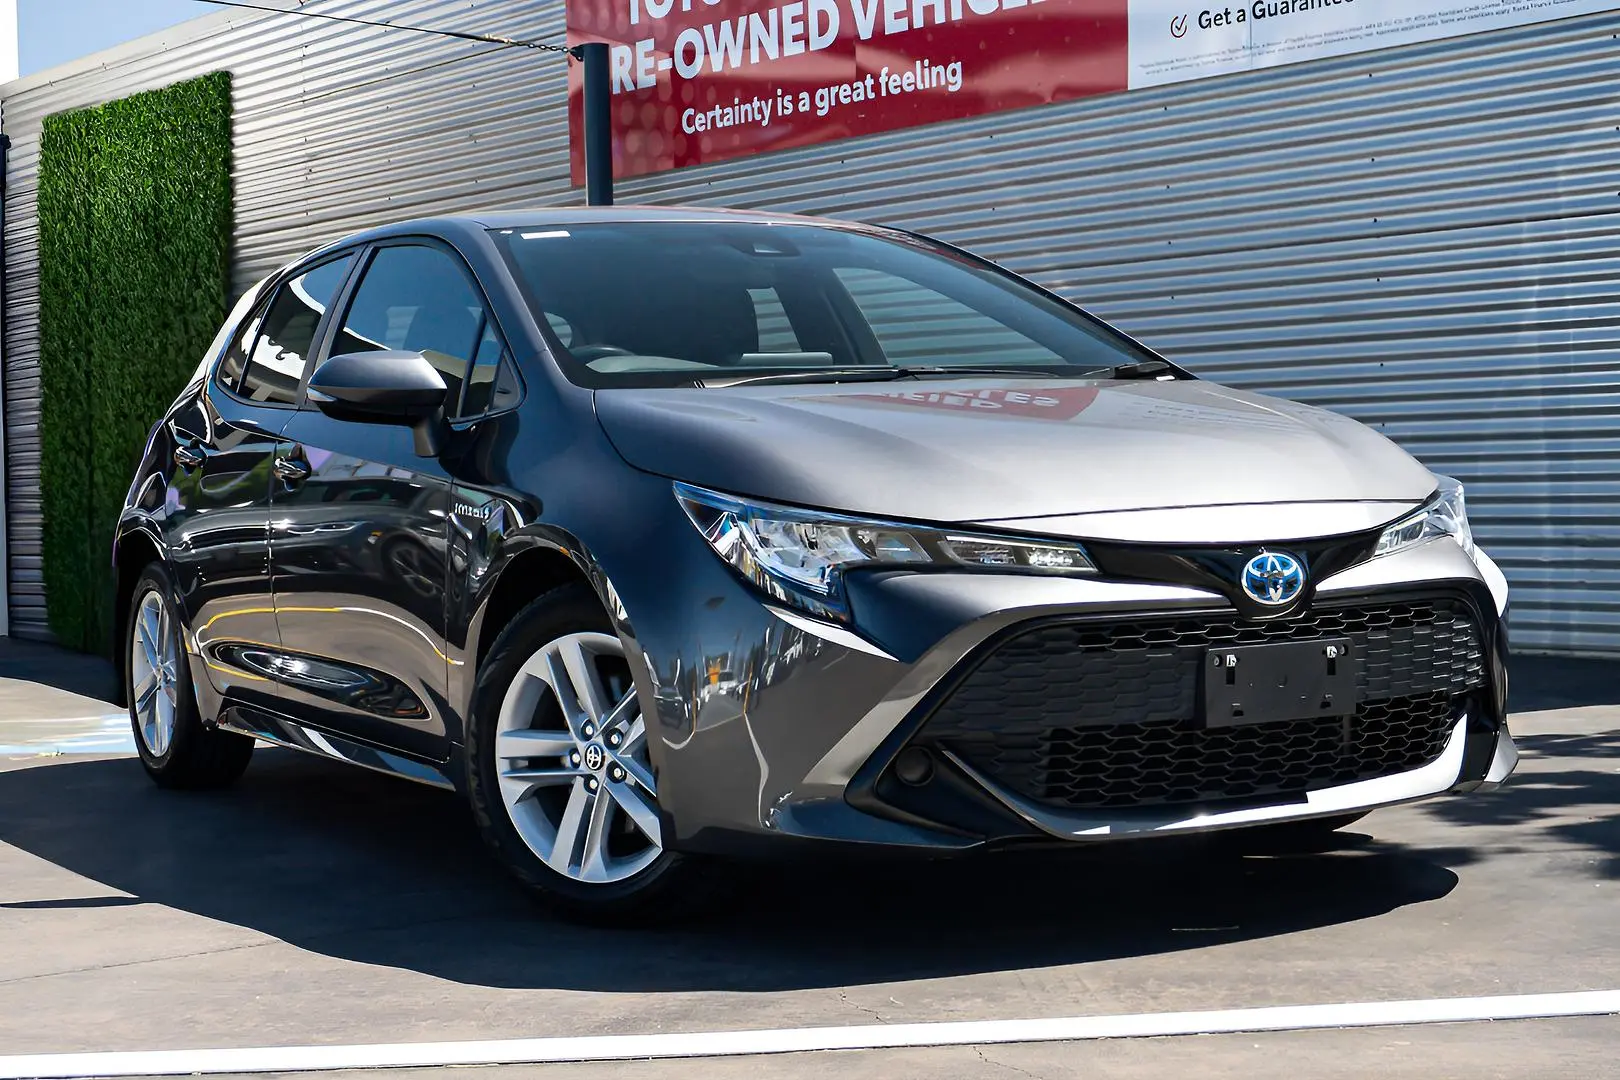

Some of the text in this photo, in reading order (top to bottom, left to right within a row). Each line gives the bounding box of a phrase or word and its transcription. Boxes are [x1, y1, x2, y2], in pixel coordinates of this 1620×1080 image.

[1198, 0, 1354, 29] Get a Guaran
[681, 59, 963, 134] Certainty is a great feeling
